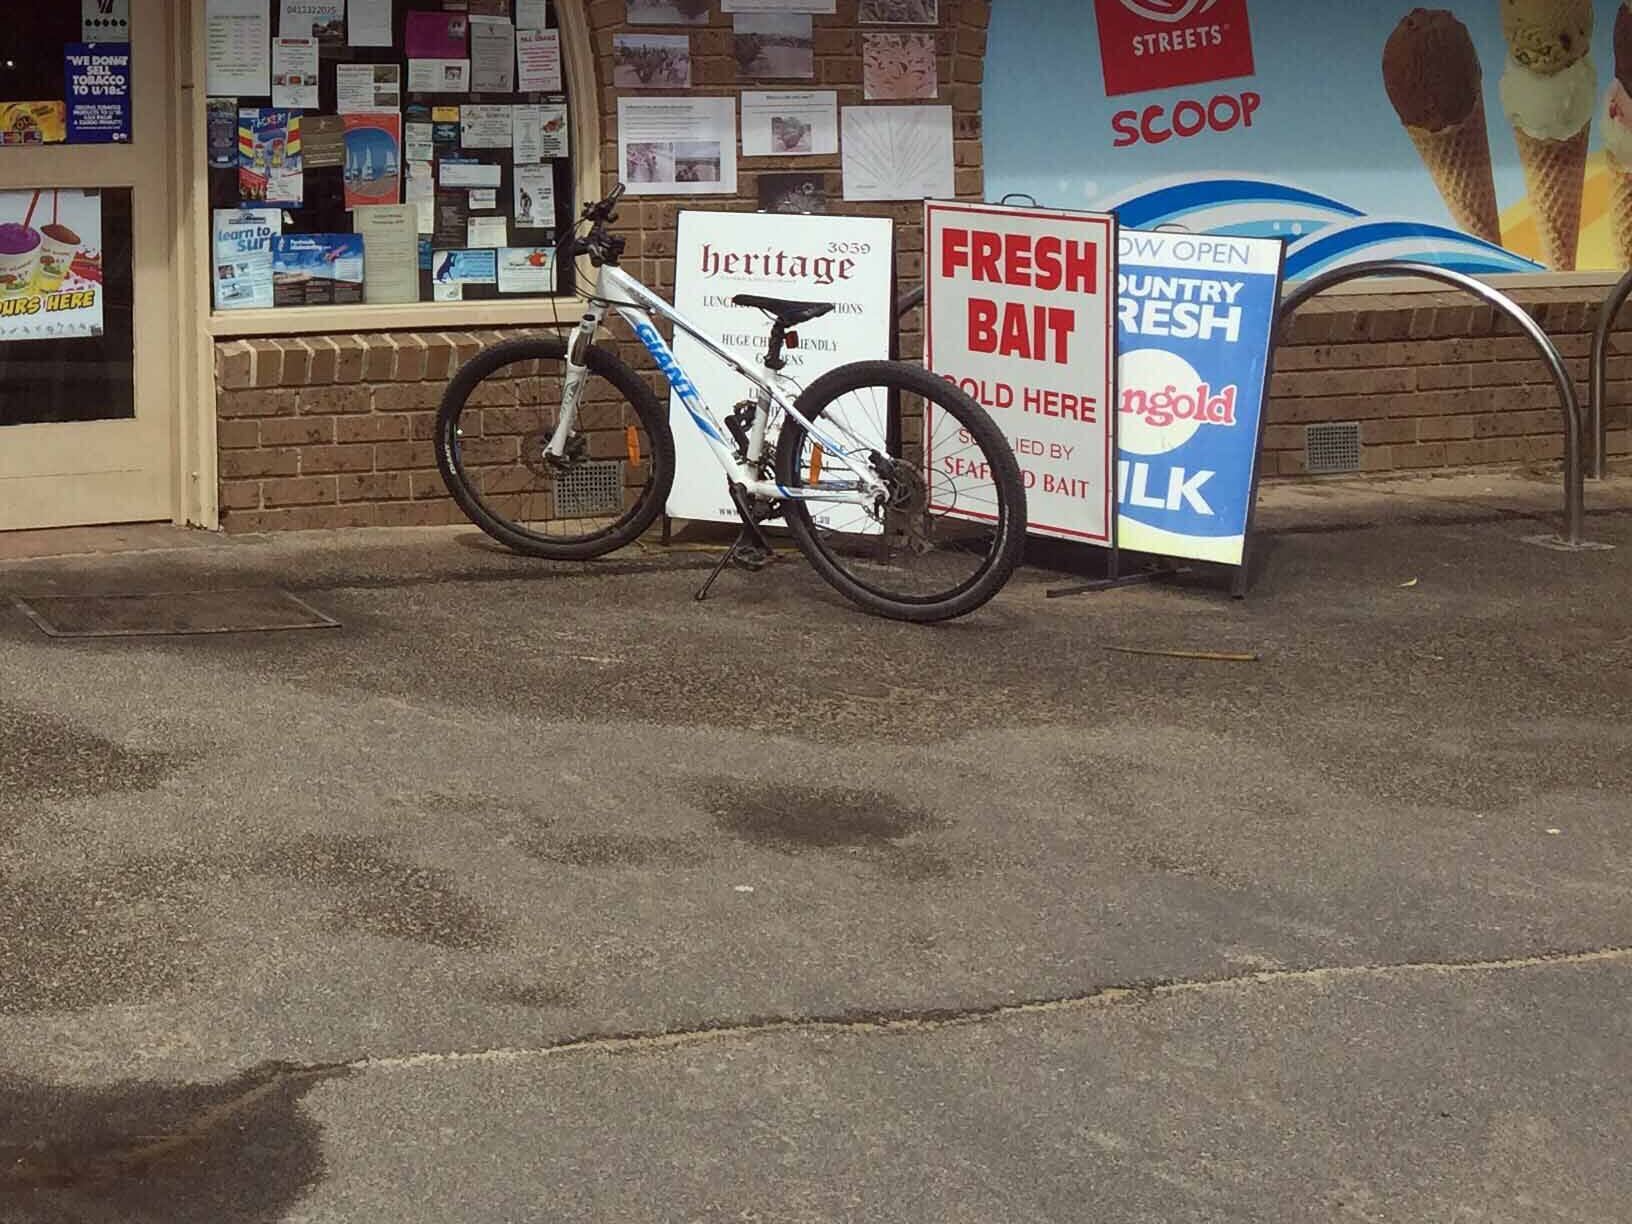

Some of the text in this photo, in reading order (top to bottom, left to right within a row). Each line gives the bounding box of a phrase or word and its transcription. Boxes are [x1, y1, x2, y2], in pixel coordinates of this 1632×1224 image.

[1132, 23, 1224, 57] STREETS
[72, 75, 125, 85] TOBACCO
[72, 85, 88, 95] TO
[1111, 92, 1261, 148] SCOOP
[701, 243, 856, 285] heritage
[942, 228, 1097, 294] FRESH
[1119, 236, 1250, 264] OW OPEN
[46, 289, 96, 312] HERE
[1118, 273, 1245, 304] UNTRY
[968, 297, 1076, 364] BAIT
[1118, 297, 1242, 342] RESH
[722, 333, 749, 347] HUGE
[635, 322, 700, 401] GIANT
[1024, 387, 1097, 423] HERE
[1118, 381, 1237, 427] ngold
[1050, 443, 1074, 460] BY
[944, 456, 1090, 498] SEAFD BAIT
[1118, 460, 1216, 516] ILK
